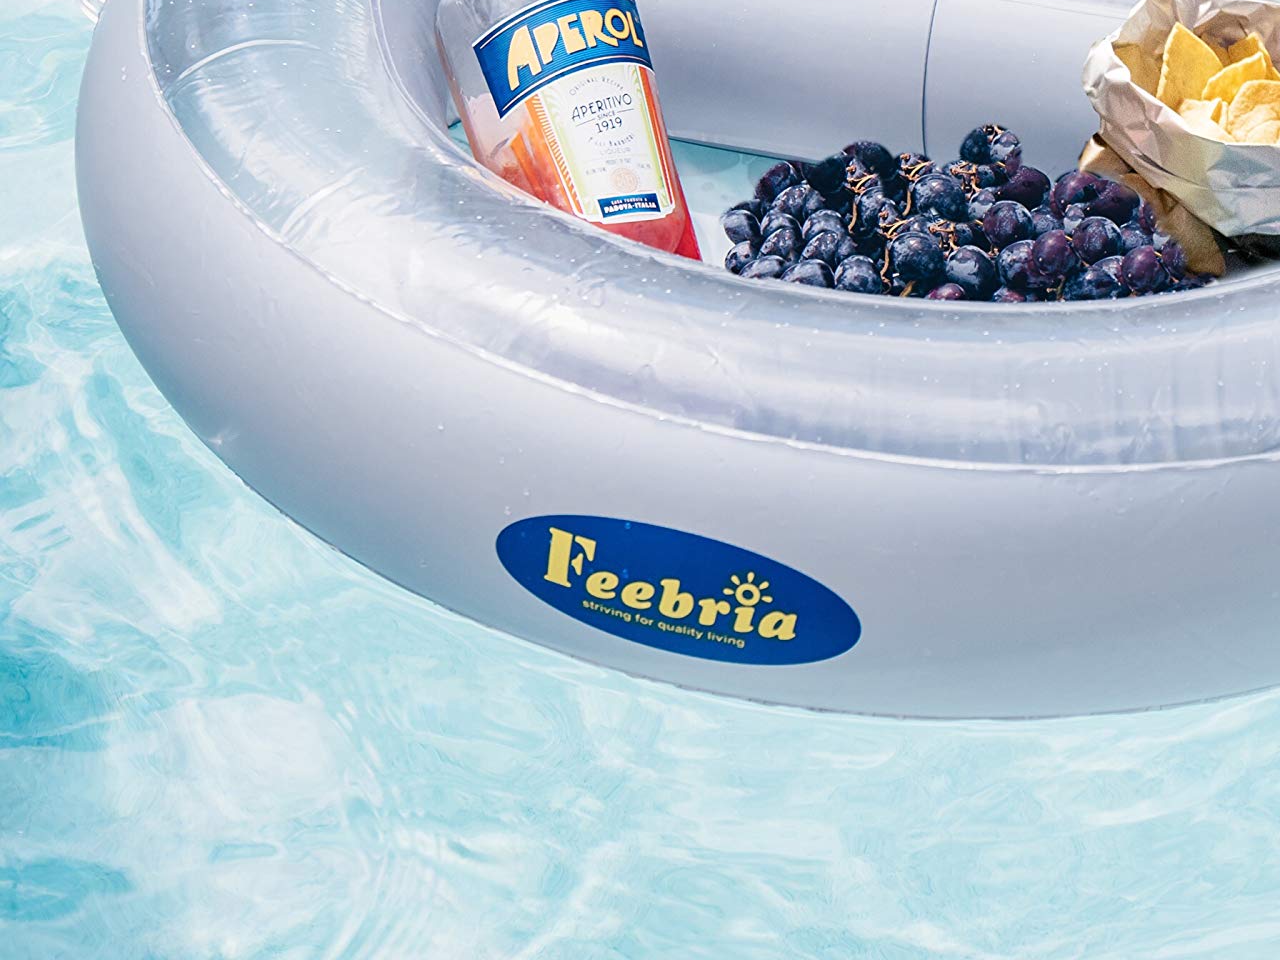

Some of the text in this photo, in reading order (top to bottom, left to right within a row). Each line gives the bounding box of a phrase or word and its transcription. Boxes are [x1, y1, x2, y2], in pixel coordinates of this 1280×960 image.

[507, 8, 644, 92] APEROL
[571, 93, 632, 121] APERITIVO
[595, 116, 622, 133] 1919
[597, 110, 616, 120] SINCE
[543, 526, 798, 641] Feebria
[582, 598, 746, 649] striving for quality living
